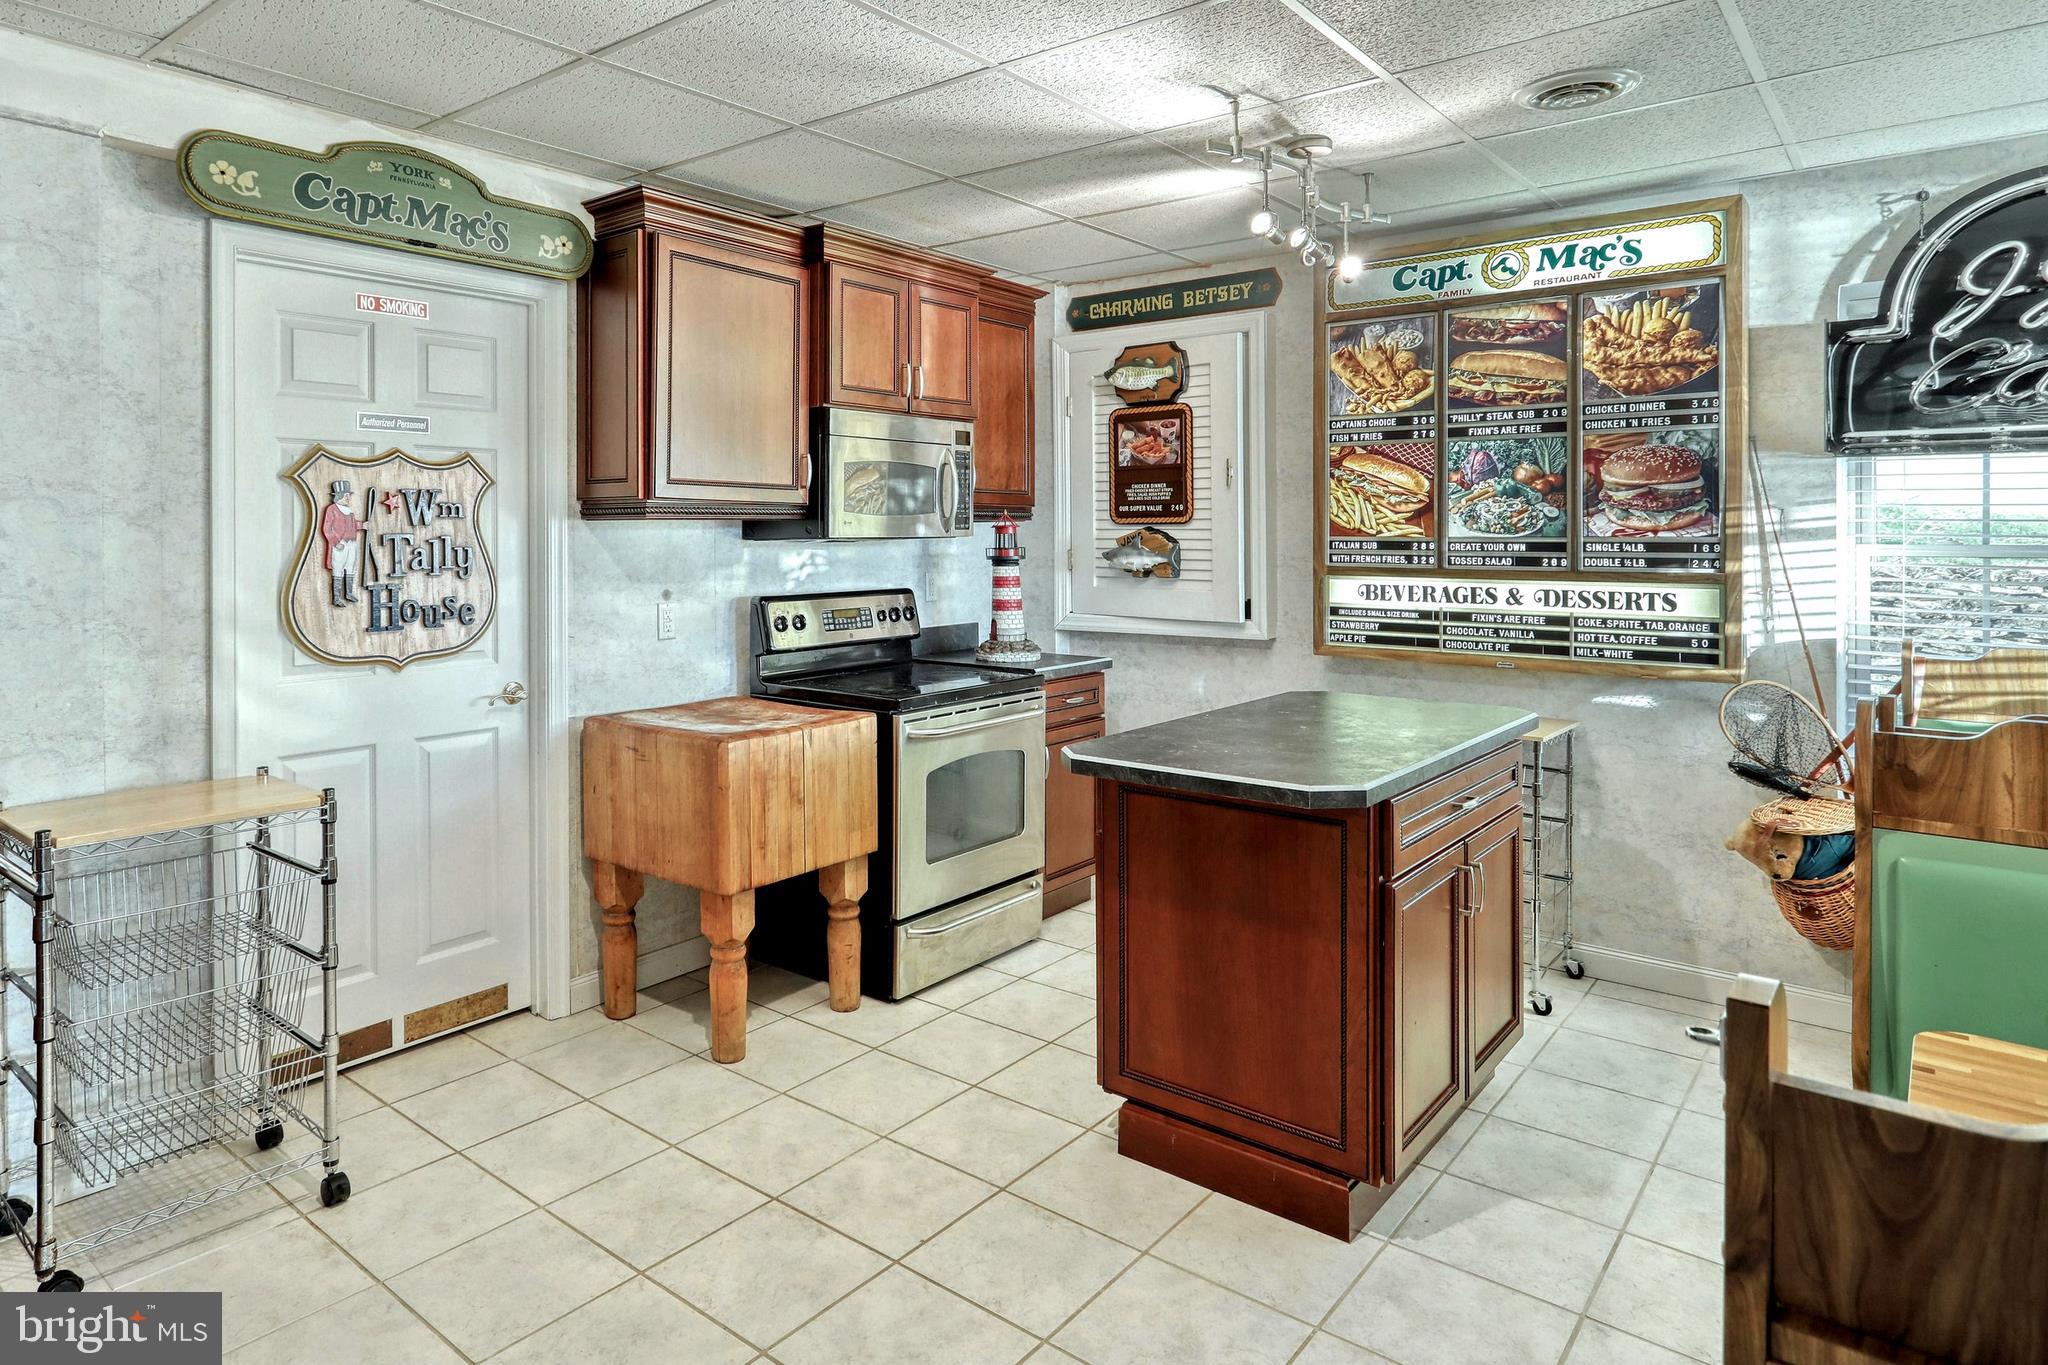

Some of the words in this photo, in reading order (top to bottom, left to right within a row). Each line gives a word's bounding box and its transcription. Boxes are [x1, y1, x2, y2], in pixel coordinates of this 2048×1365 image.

[389, 161, 435, 181] YORK
[389, 174, 437, 190] PENNSYLVANIA
[1392, 258, 1474, 292] Capt.
[1536, 234, 1643, 272] Mac's
[1437, 288, 1473, 299] FAMILY
[1533, 272, 1602, 287] RESTAURANT
[359, 295, 376, 311] NO
[380, 298, 426, 318] SMOKING
[1089, 293, 1174, 320] CHARMING
[1183, 282, 1254, 308] BETSEY
[1585, 404, 1626, 414] CHICKEN
[1629, 402, 1666, 412] DINNER
[1486, 411, 1514, 420] STEAK
[1517, 410, 1534, 418] SUB
[361, 416, 396, 428] Authorized
[397, 419, 427, 430] Personnel
[1331, 420, 1366, 428] CAPTAINS
[1368, 418, 1396, 426] CHOICE
[1585, 420, 1626, 429] CHICKEN
[1642, 417, 1671, 426] FRIES
[1468, 426, 1499, 436] FIXIN'S
[1500, 426, 1517, 434] ARE
[1520, 425, 1542, 433] FREE
[400, 488, 465, 528] Wm
[382, 532, 474, 581] Tally
[1358, 584, 1498, 605] BEVERAGES
[1505, 588, 1524, 606] &
[1534, 588, 1678, 612] DESSERTS
[365, 584, 476, 634] House
[1472, 614, 1502, 622] FIXIN'S
[1522, 616, 1546, 624] FREE
[1332, 621, 1379, 630] STRAWBERRY
[1668, 623, 1708, 632] ORANGE
[1499, 630, 1534, 639] VANILLA
[1620, 636, 1657, 645] COFFEE
[1446, 641, 1493, 650] CHOCOLATE
[1576, 648, 1633, 659] MILK-WHITE
